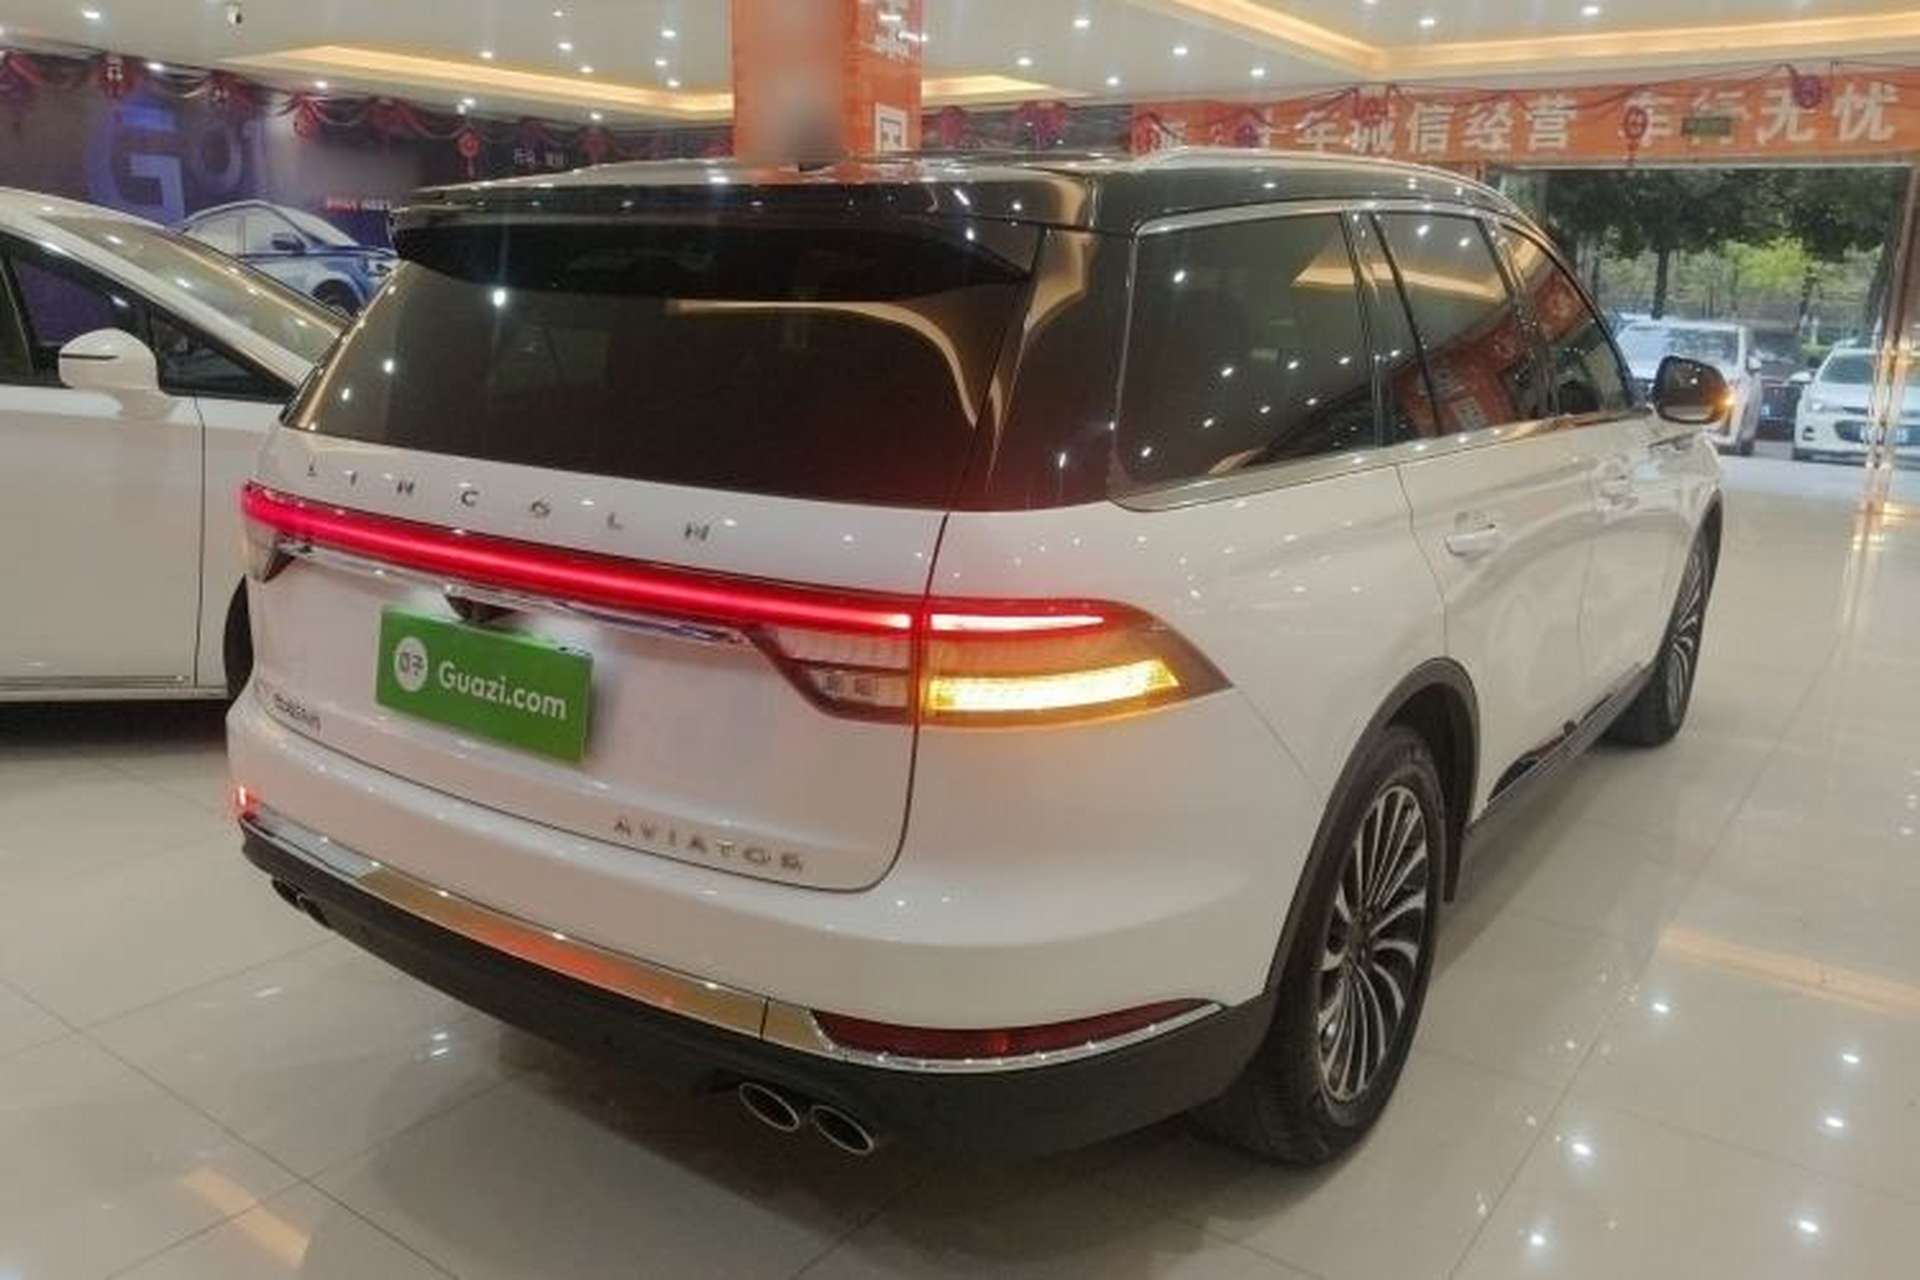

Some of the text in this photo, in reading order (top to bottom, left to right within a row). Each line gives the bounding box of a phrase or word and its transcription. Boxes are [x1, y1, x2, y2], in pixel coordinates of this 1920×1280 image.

[305, 461, 710, 542] LINCOLN
[438, 660, 567, 720] Guazi.com
[613, 814, 804, 873] AVIATOR
